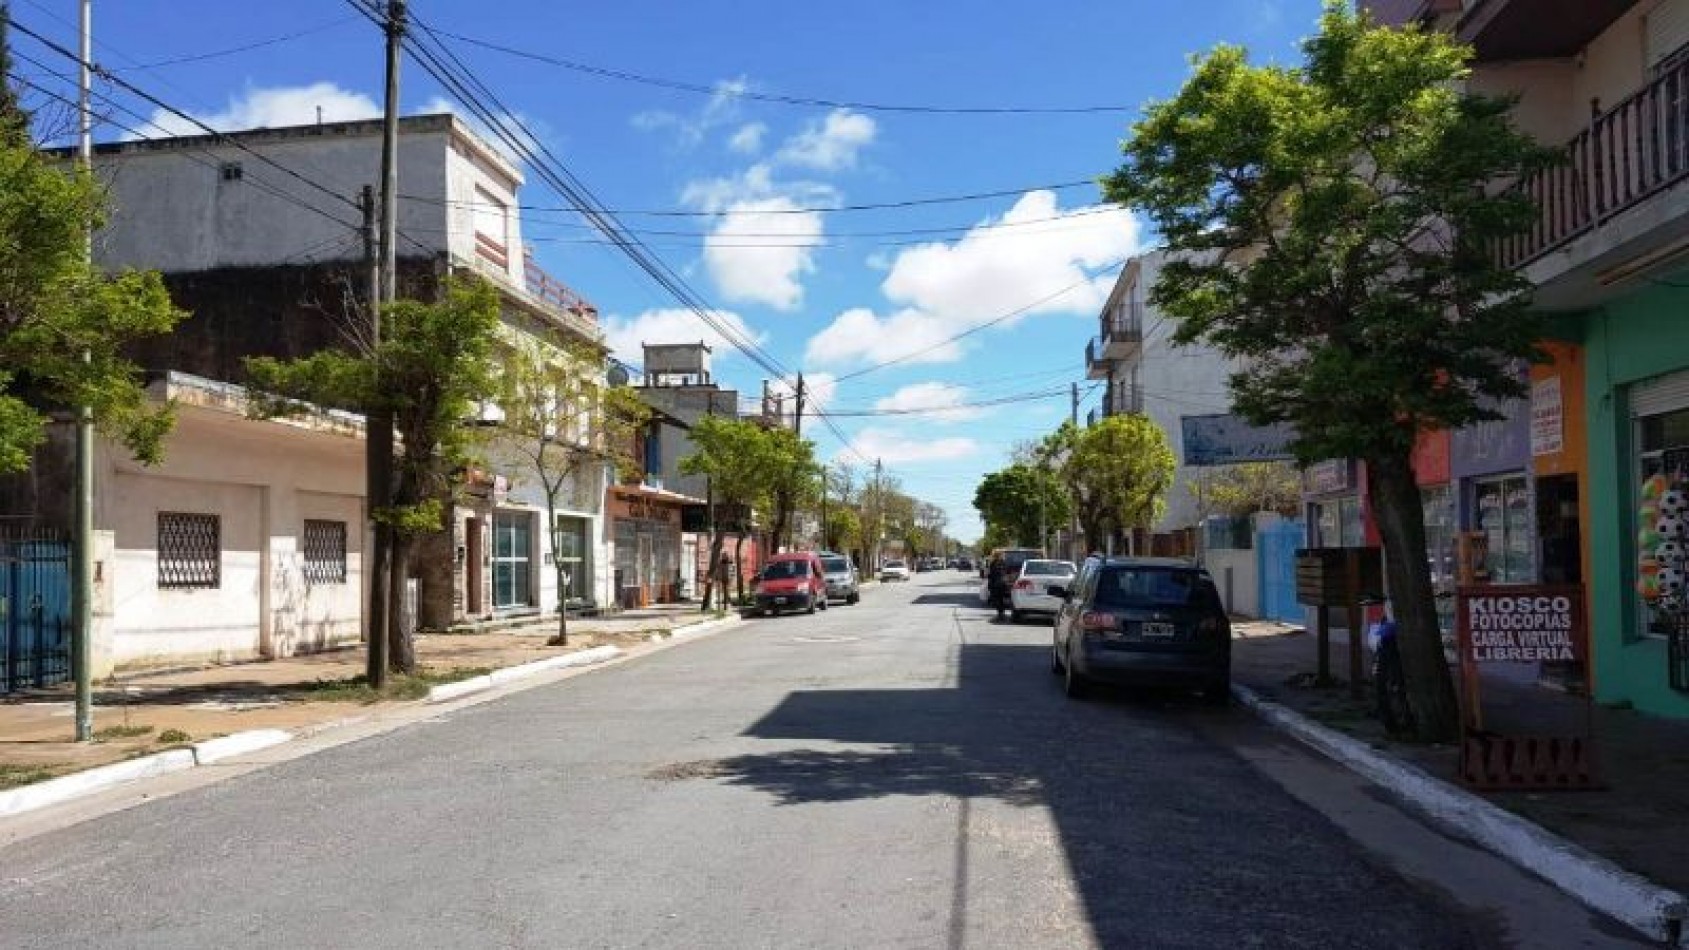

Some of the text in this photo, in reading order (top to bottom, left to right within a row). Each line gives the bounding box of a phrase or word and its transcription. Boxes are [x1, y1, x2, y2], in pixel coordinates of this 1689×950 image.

[1469, 597, 1570, 613] KIOSCO
[1470, 614, 1571, 629] FOTOCOPIAS
[1471, 630, 1573, 646] CARGA VIRTUAL
[1473, 647, 1574, 660] LIBRERIA
